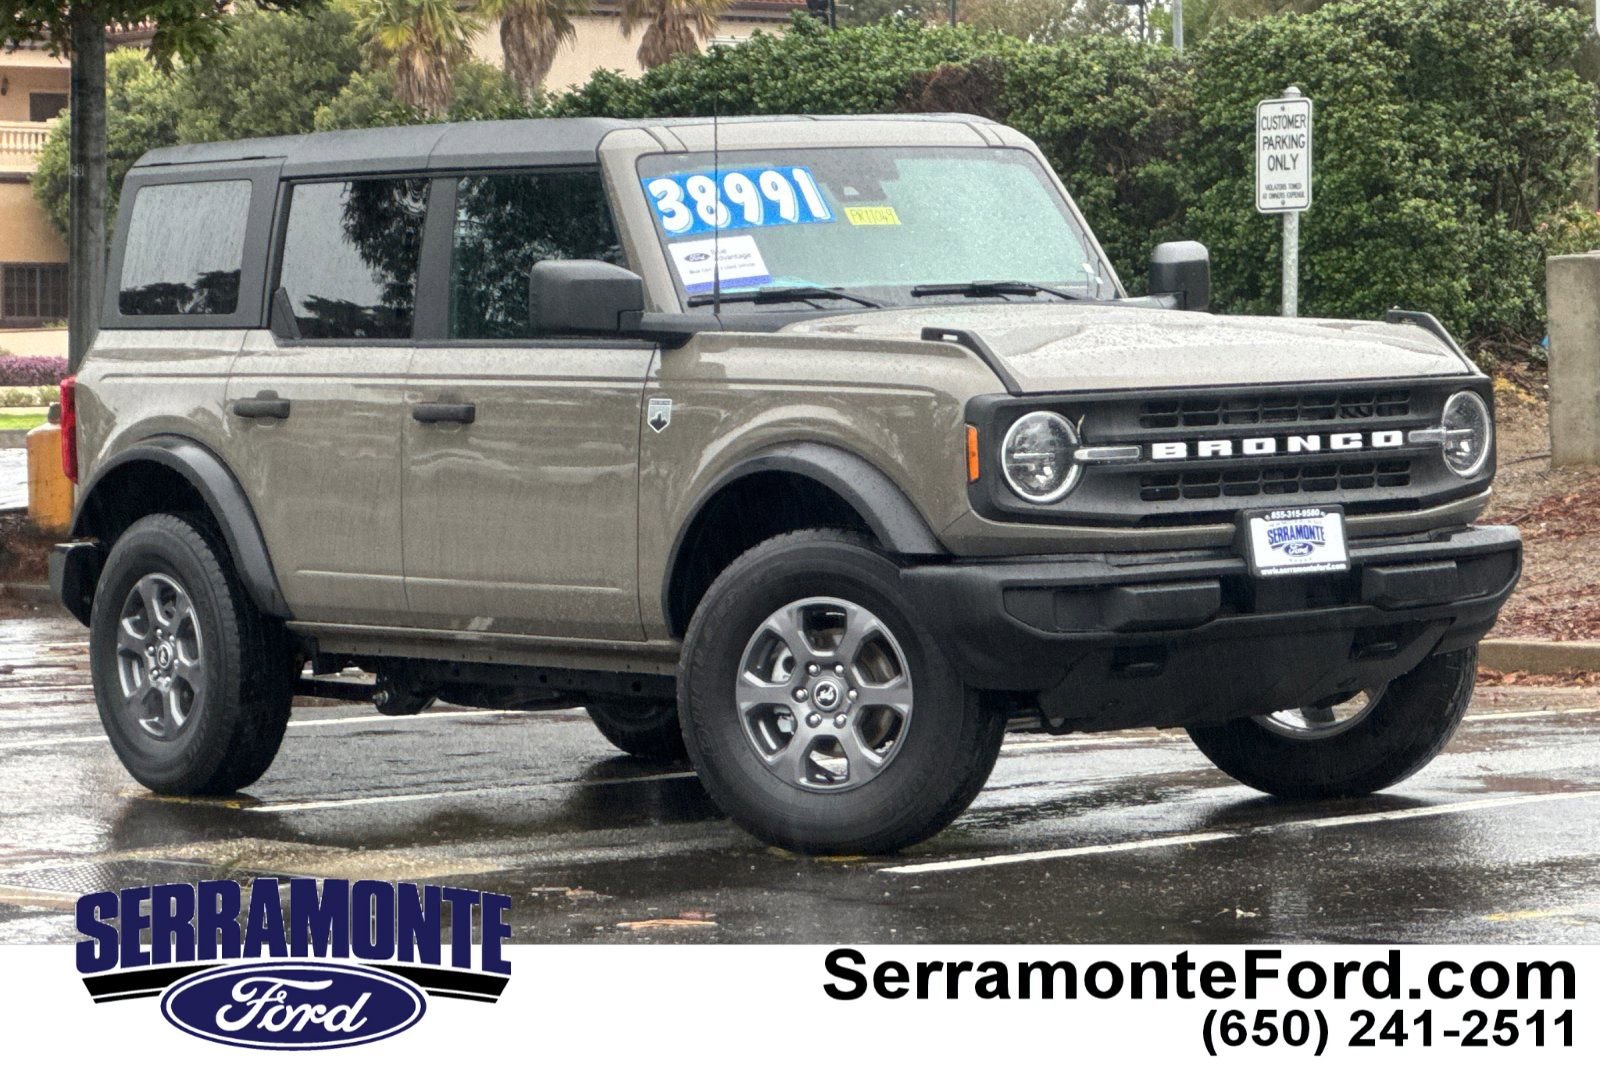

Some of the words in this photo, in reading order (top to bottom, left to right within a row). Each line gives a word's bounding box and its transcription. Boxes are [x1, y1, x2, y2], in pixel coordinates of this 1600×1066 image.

[1261, 114, 1306, 131] CUSTOMER
[1262, 134, 1306, 151] PARKING
[1267, 154, 1299, 171] ONLY
[648, 168, 832, 234] 38991
[1152, 430, 1403, 460] BRONCO
[1267, 524, 1325, 545] SERRAMONTE
[1288, 543, 1309, 554] Ford
